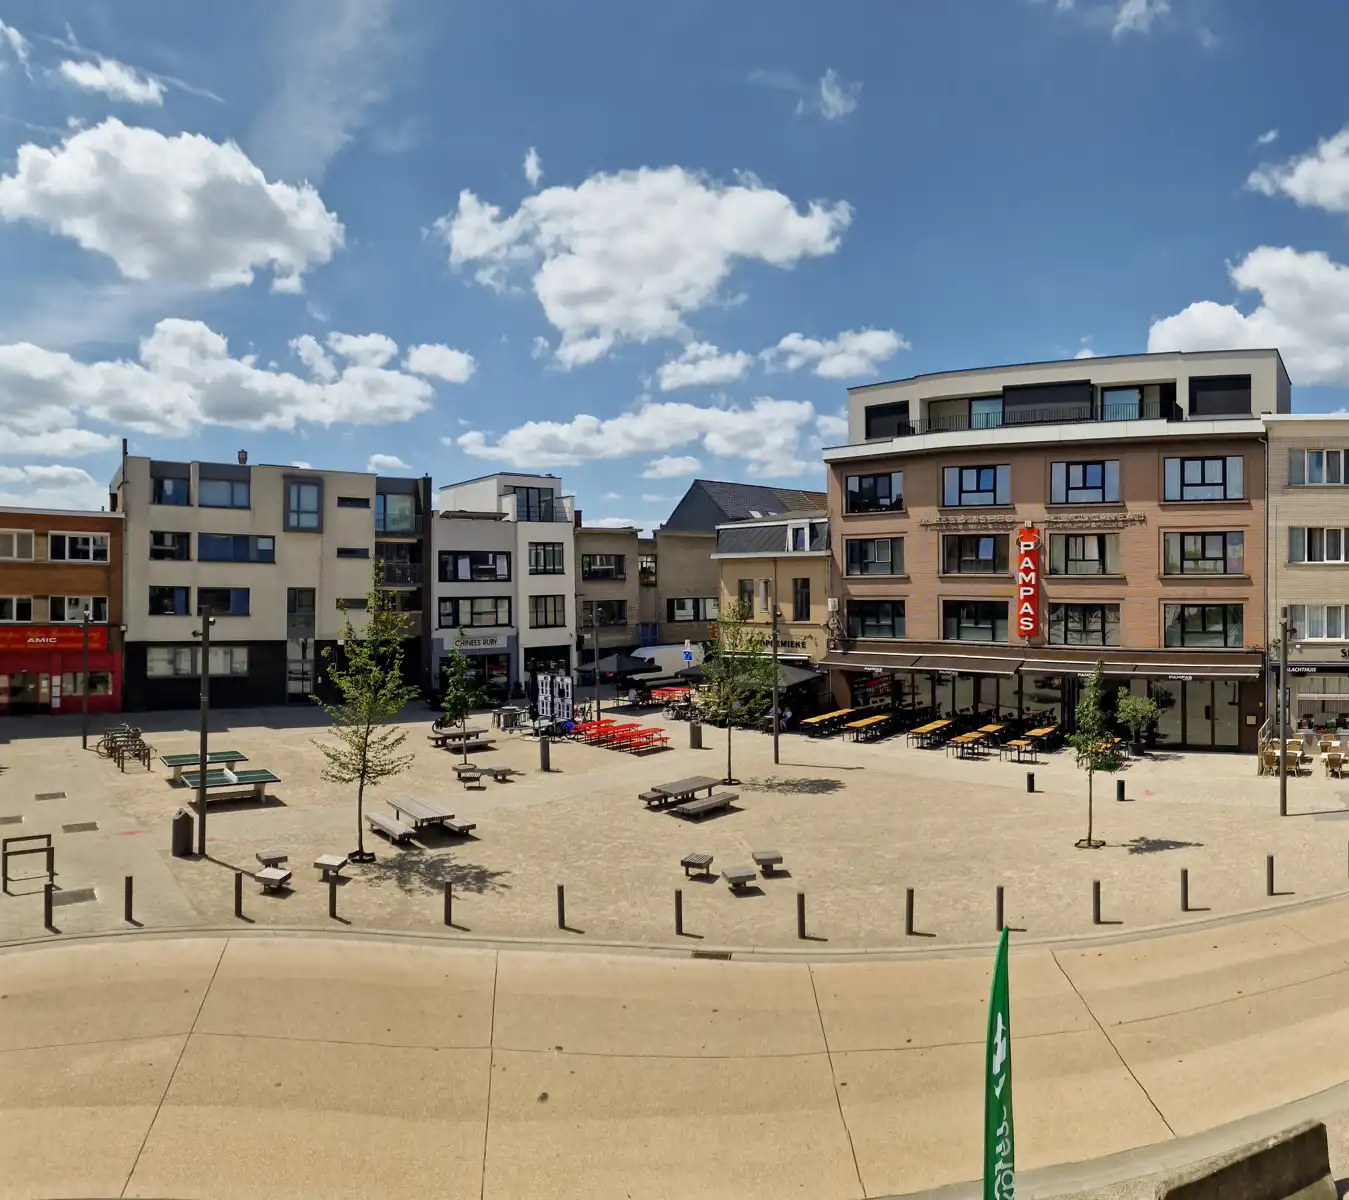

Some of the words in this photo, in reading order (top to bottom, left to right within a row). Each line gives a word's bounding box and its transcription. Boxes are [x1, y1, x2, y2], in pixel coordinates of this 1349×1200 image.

[1018, 541, 1037, 631] PAMPAS
[454, 639, 482, 647] CHINEES
[482, 638, 498, 646] RUBY
